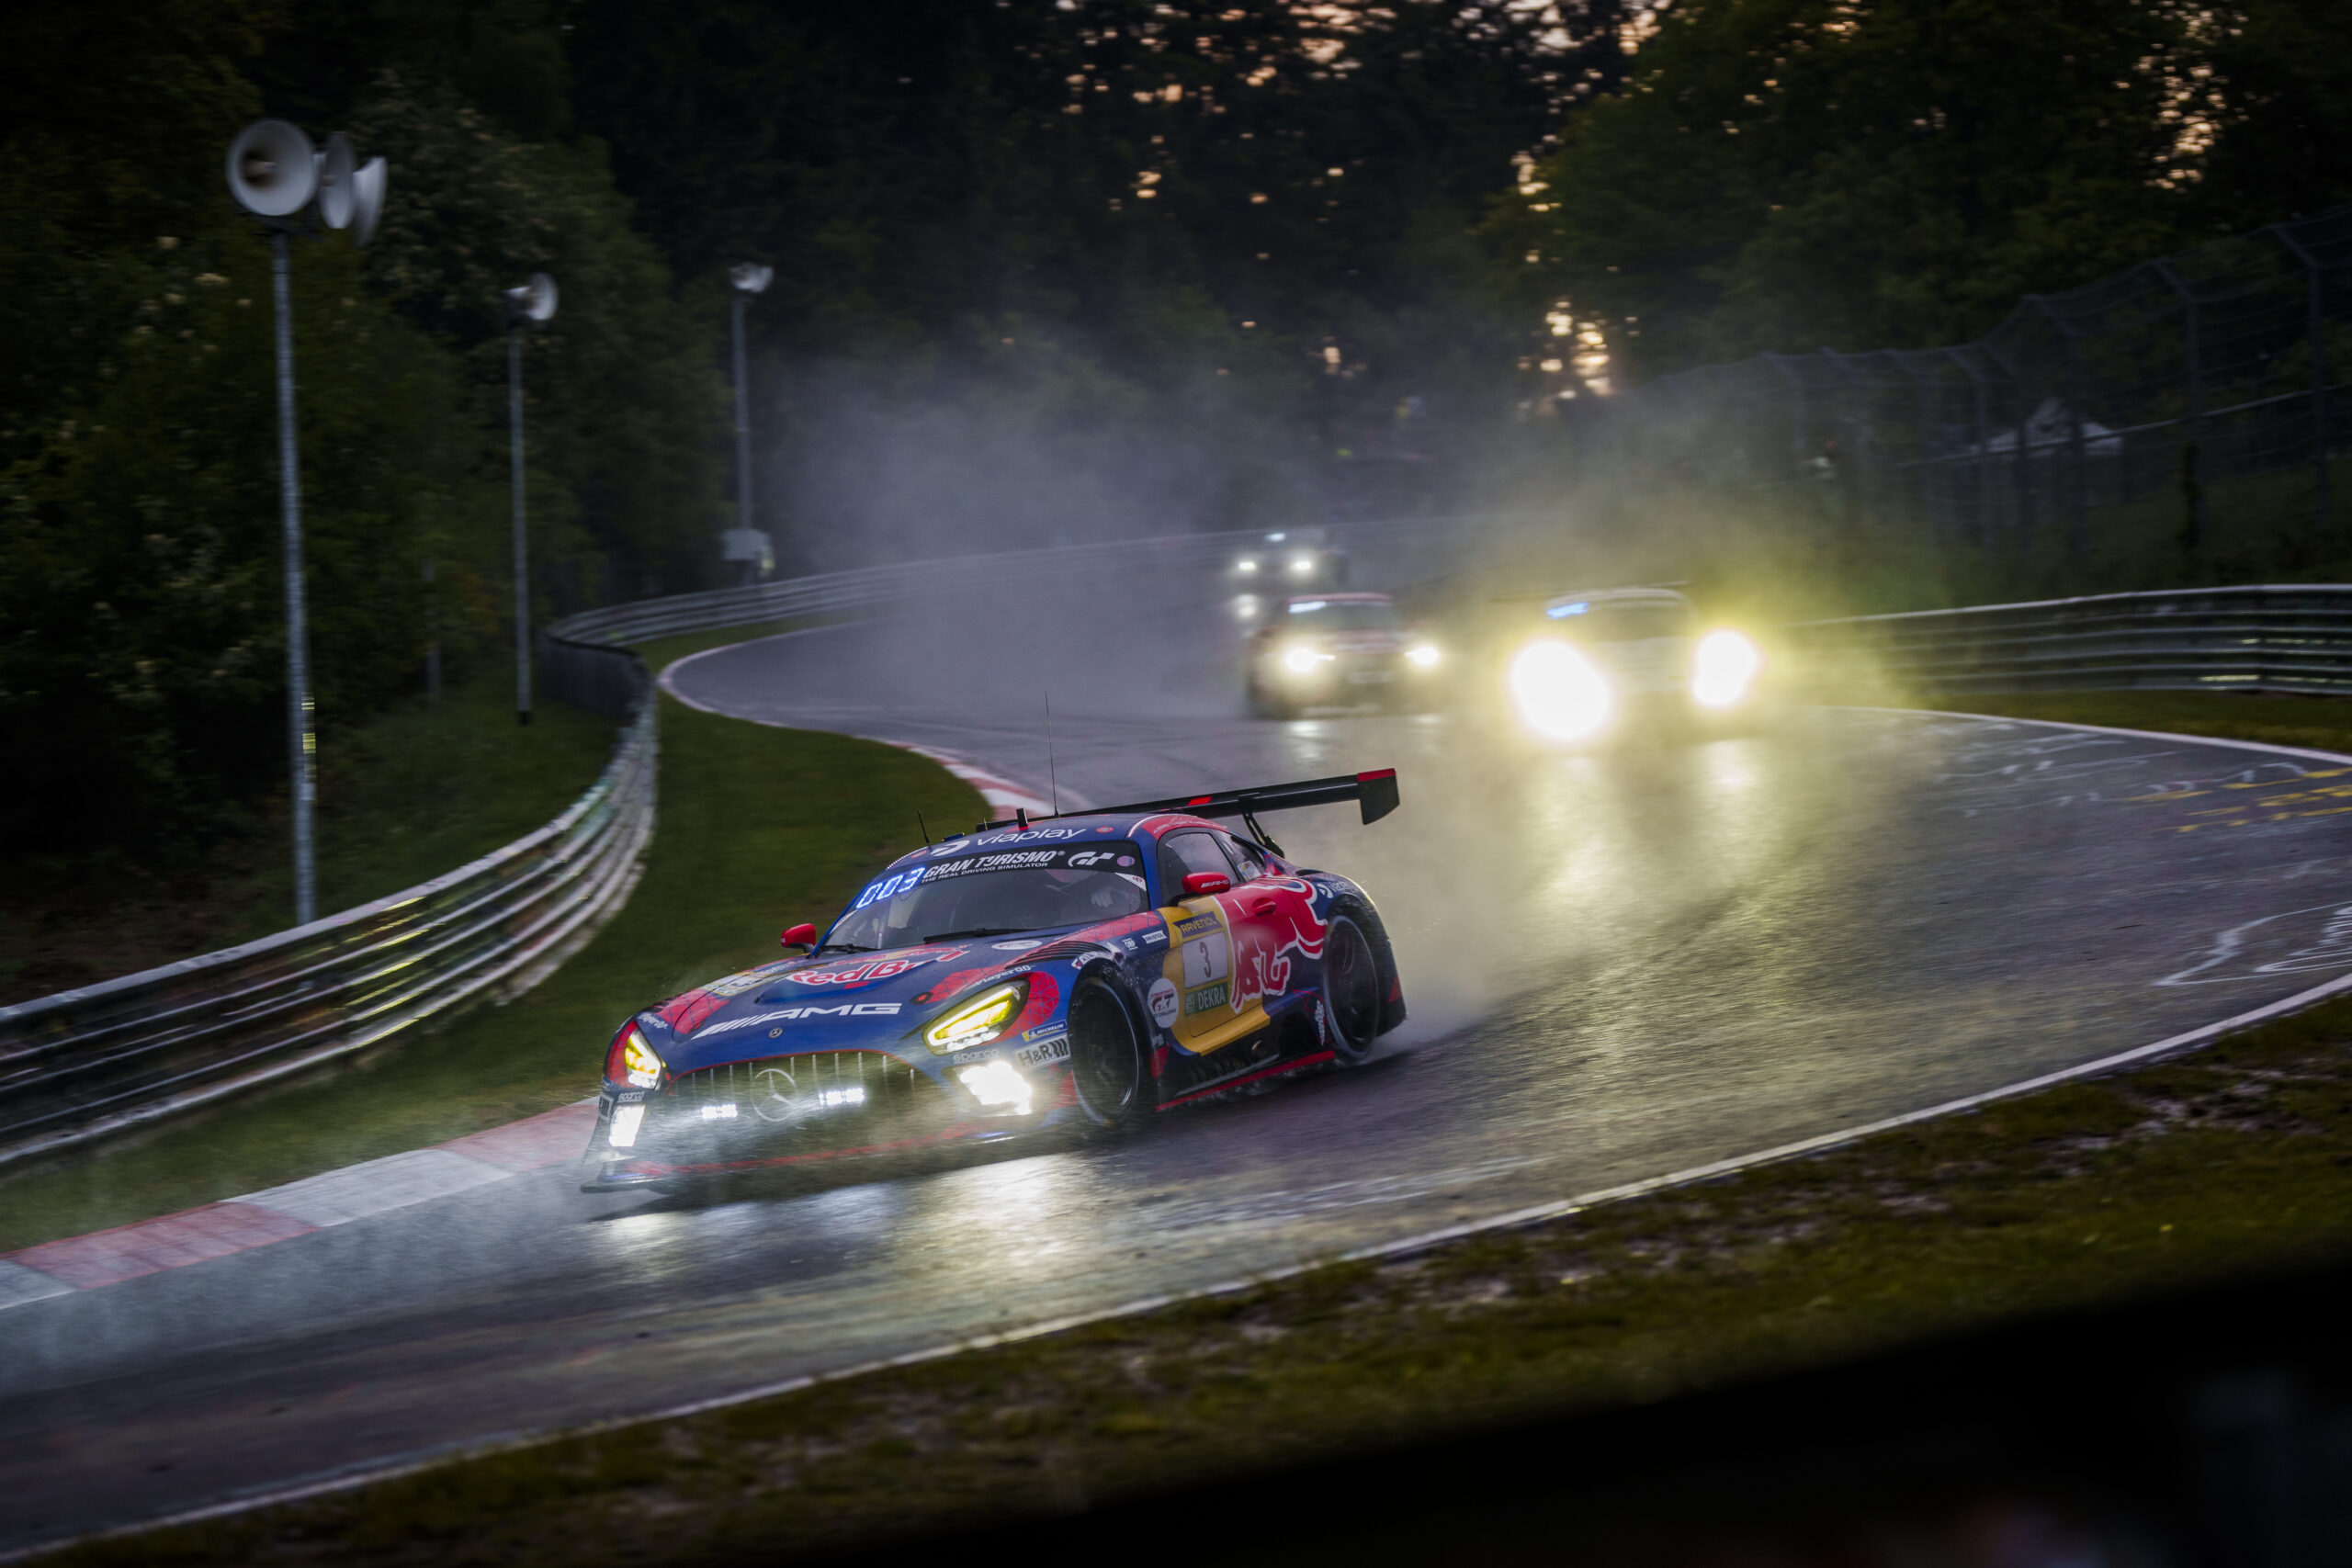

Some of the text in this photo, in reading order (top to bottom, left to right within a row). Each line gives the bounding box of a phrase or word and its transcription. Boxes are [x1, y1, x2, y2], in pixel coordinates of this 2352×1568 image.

[977, 829, 1087, 846] viaplay
[922, 851, 1057, 879] GRAN TURISMO
[938, 872, 959, 880] REAL
[960, 866, 996, 876] DRIVING
[997, 863, 1048, 871] SIMULATOR
[855, 866, 927, 909] 003
[1181, 918, 1217, 934] RAVENOL
[1199, 941, 1213, 979] 3
[787, 963, 871, 986] Red
[1197, 986, 1227, 1010] DEKRA
[1036, 1023, 1064, 1034] MICHELIN
[953, 1049, 1000, 1063] sparco
[1018, 1043, 1052, 1068] H&R
[618, 1091, 645, 1101] sparco
